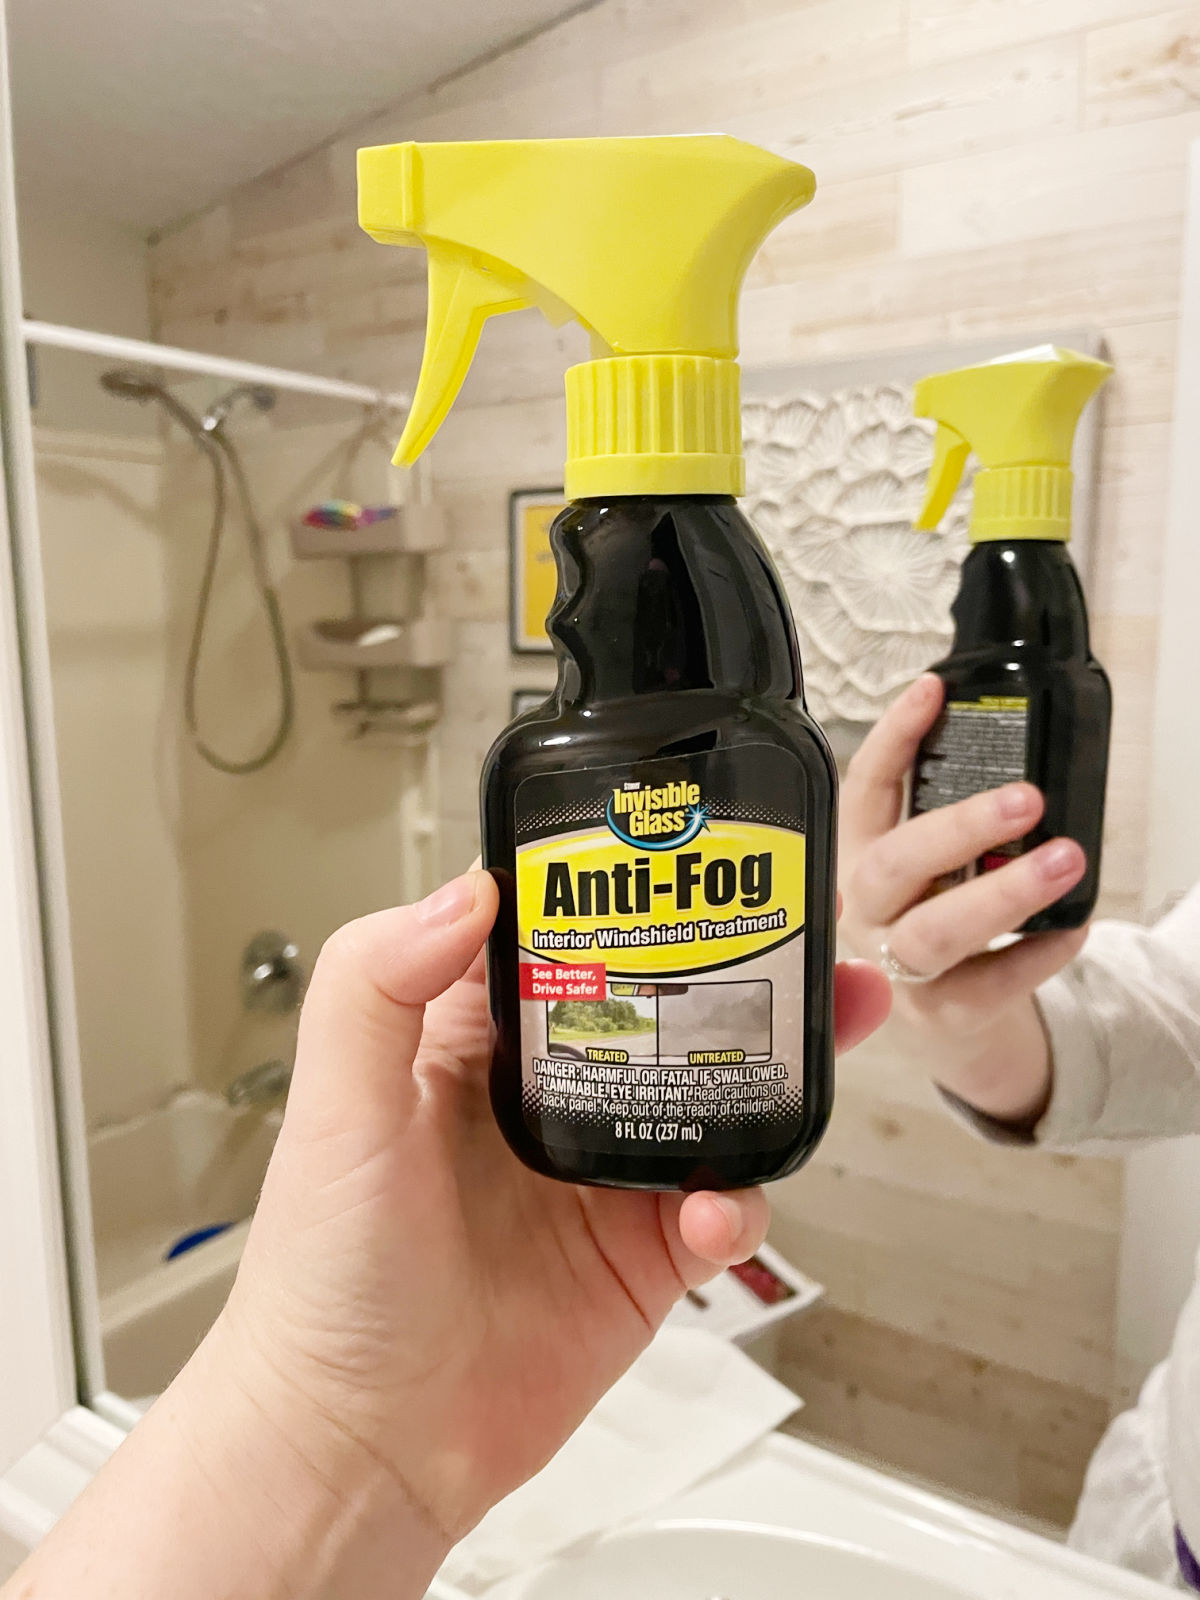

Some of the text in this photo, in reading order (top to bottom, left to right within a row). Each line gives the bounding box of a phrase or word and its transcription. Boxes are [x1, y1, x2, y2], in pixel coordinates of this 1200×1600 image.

[612, 781, 700, 814] Invisible
[629, 810, 686, 837] Glass
[543, 852, 772, 916] Anti-Fog
[533, 910, 785, 949] Interior Windshield Treatment
[532, 968, 596, 982] See Better,
[532, 983, 598, 996] Drive Safer
[587, 1049, 627, 1062] TREATED
[689, 1051, 744, 1064] UNTREATED
[533, 1059, 788, 1085] DANGER: HARMFUL OR FATAL IF SWALLOWED.
[537, 1075, 785, 1101] FLAMMABLE. EYE IRRITANT. Read cautions on
[542, 1093, 566, 1108] back
[603, 1099, 630, 1117] Keep
[632, 1101, 650, 1116] out
[652, 1102, 664, 1116] of
[666, 1102, 684, 1116] the
[687, 1102, 718, 1117] reach
[720, 1101, 732, 1115] of
[615, 1121, 703, 1143] 8 FL OZ (237 mL)
